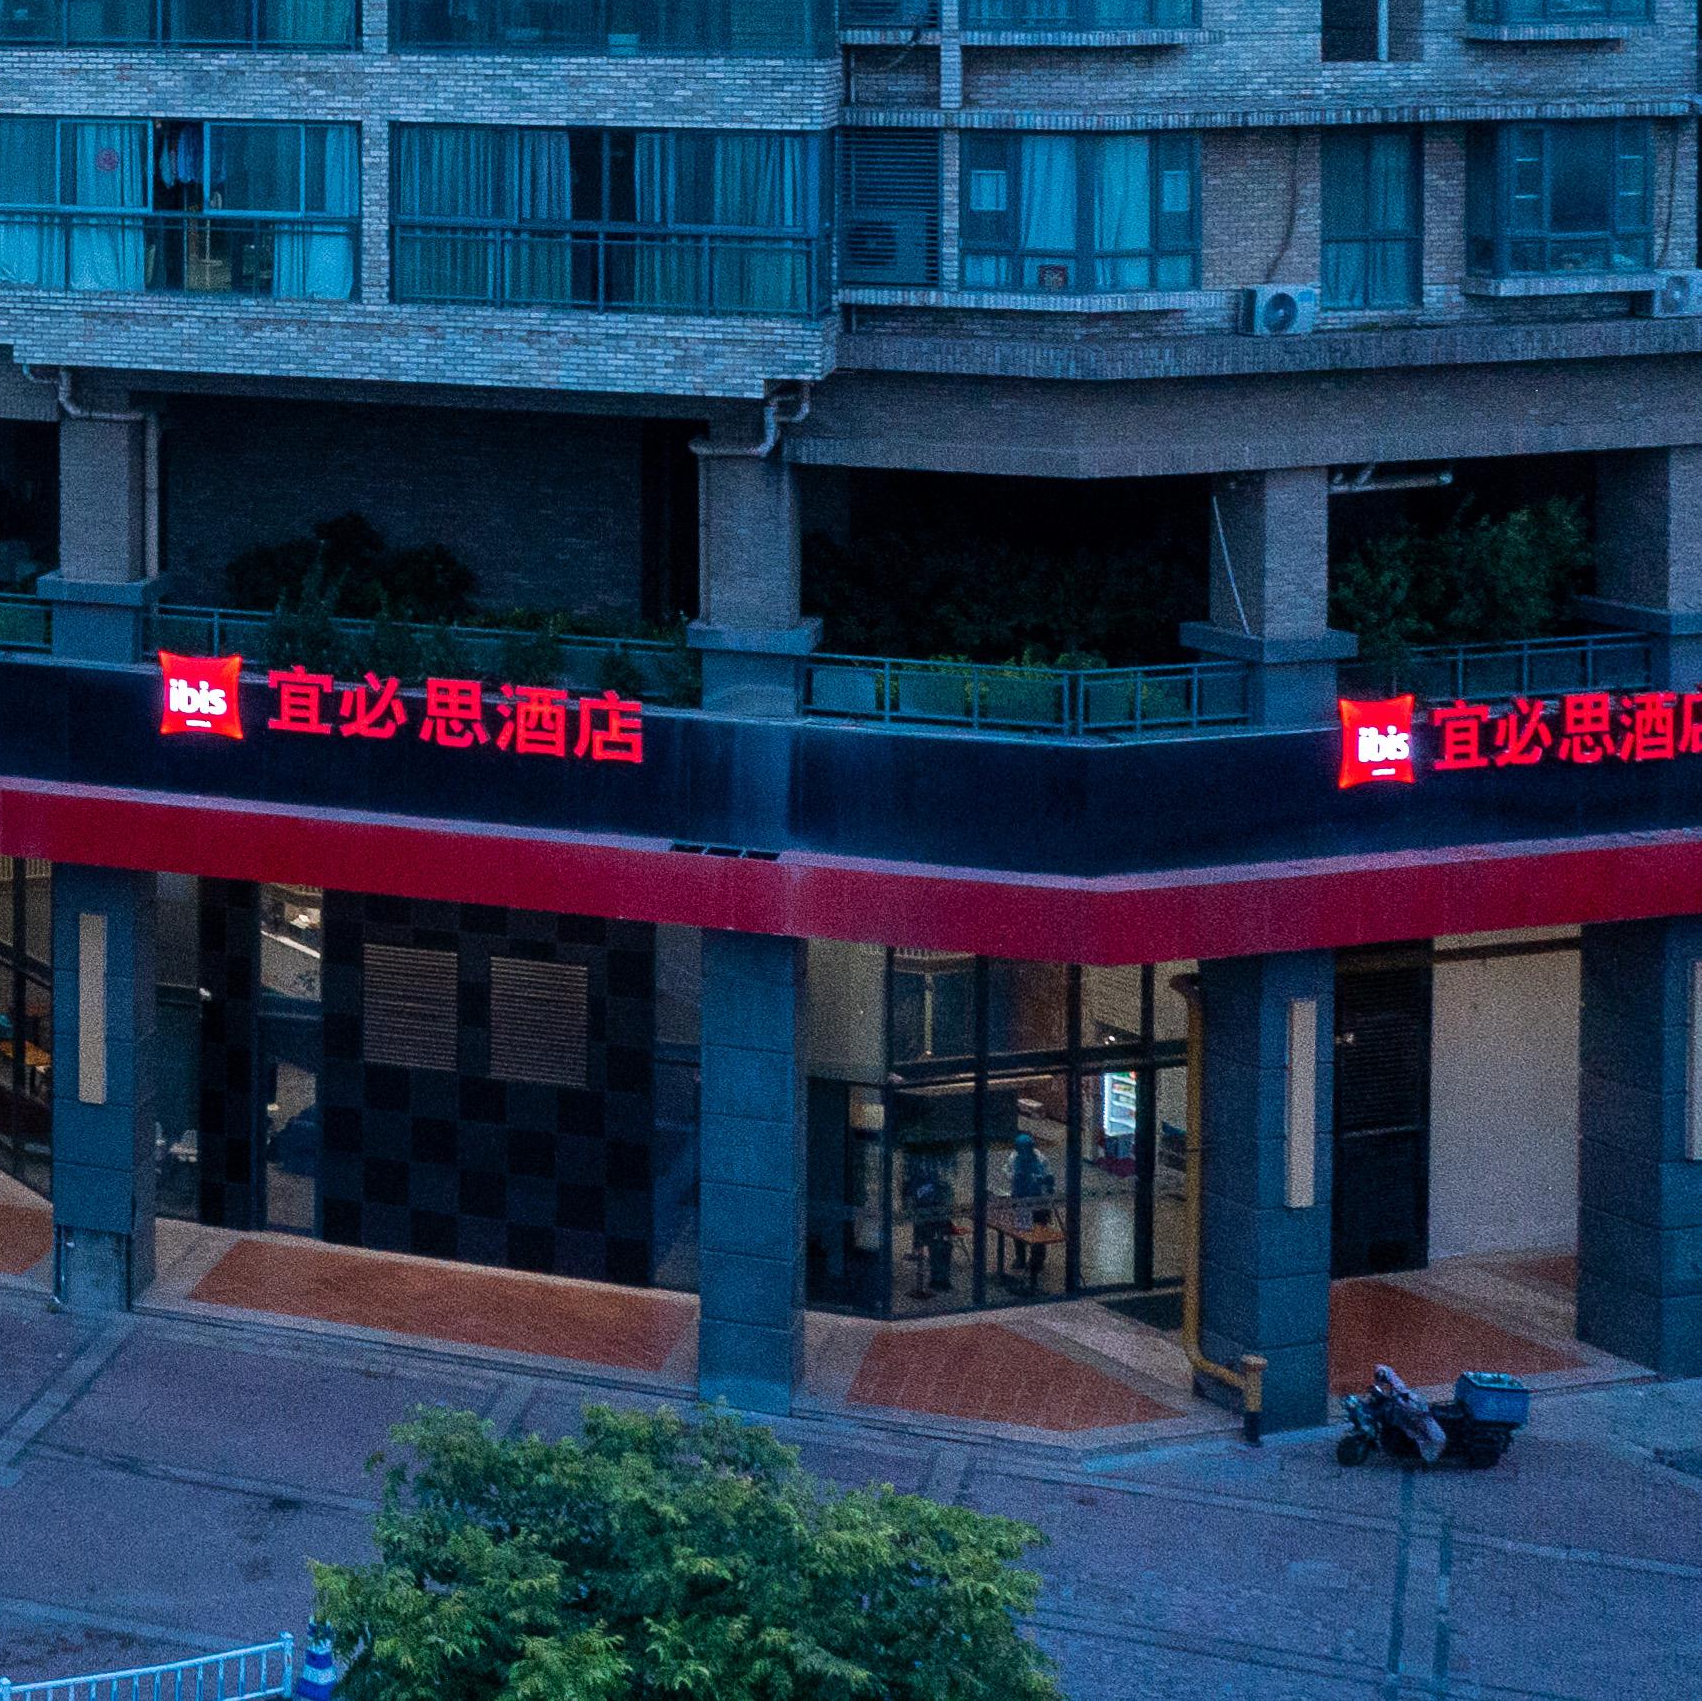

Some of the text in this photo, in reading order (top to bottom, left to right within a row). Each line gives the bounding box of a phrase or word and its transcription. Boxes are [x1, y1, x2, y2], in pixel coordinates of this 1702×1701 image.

[169, 678, 228, 715] ibis
[267, 665, 644, 763] 宜必思酒店
[1358, 725, 1410, 763] ibis
